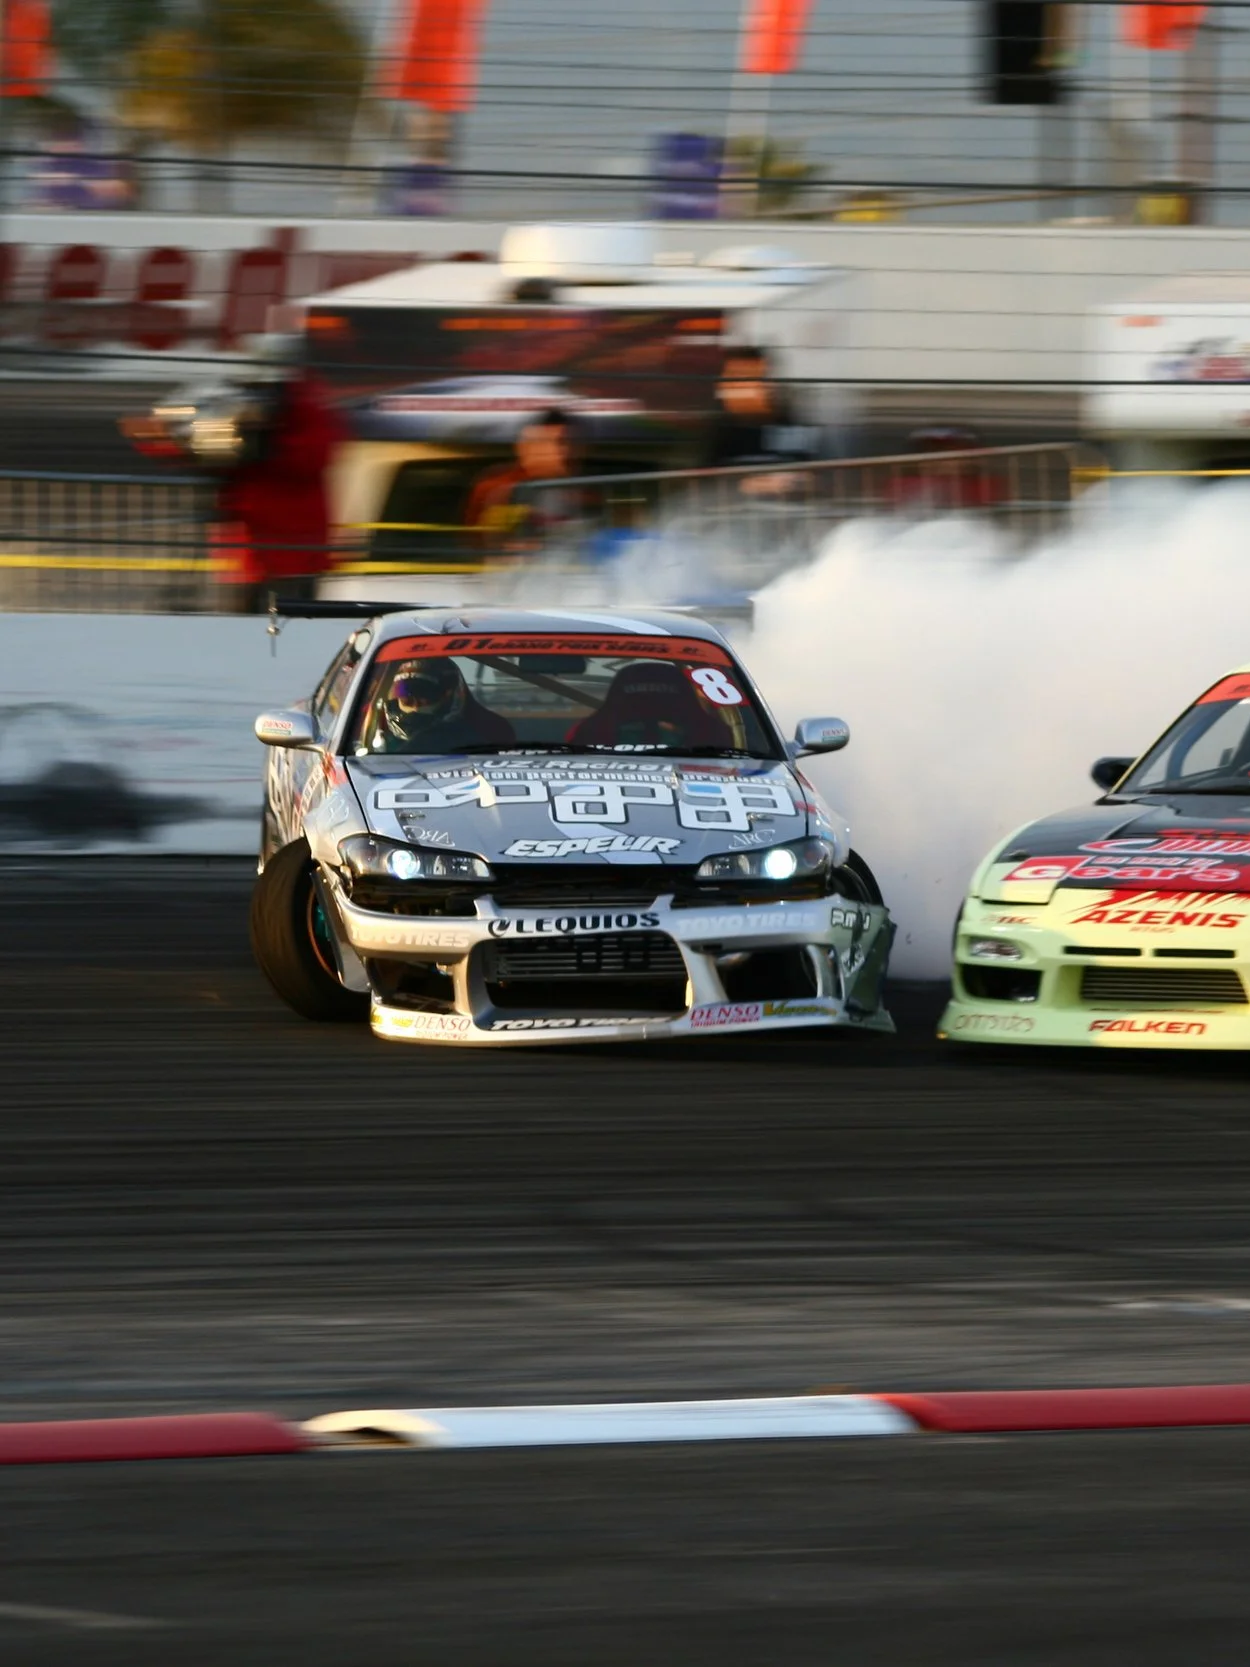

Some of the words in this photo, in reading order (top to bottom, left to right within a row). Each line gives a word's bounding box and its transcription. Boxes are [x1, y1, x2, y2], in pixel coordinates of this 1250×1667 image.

[692, 668, 742, 705] 8
[501, 836, 685, 857] ESPELIR
[515, 912, 661, 934] LEQUIOS
[746, 911, 817, 928] TIRES
[1068, 910, 1248, 928] AZENIS
[690, 1005, 760, 1021] DENSO
[415, 1015, 472, 1032] DENSO
[1088, 1020, 1208, 1036] FALKEN
